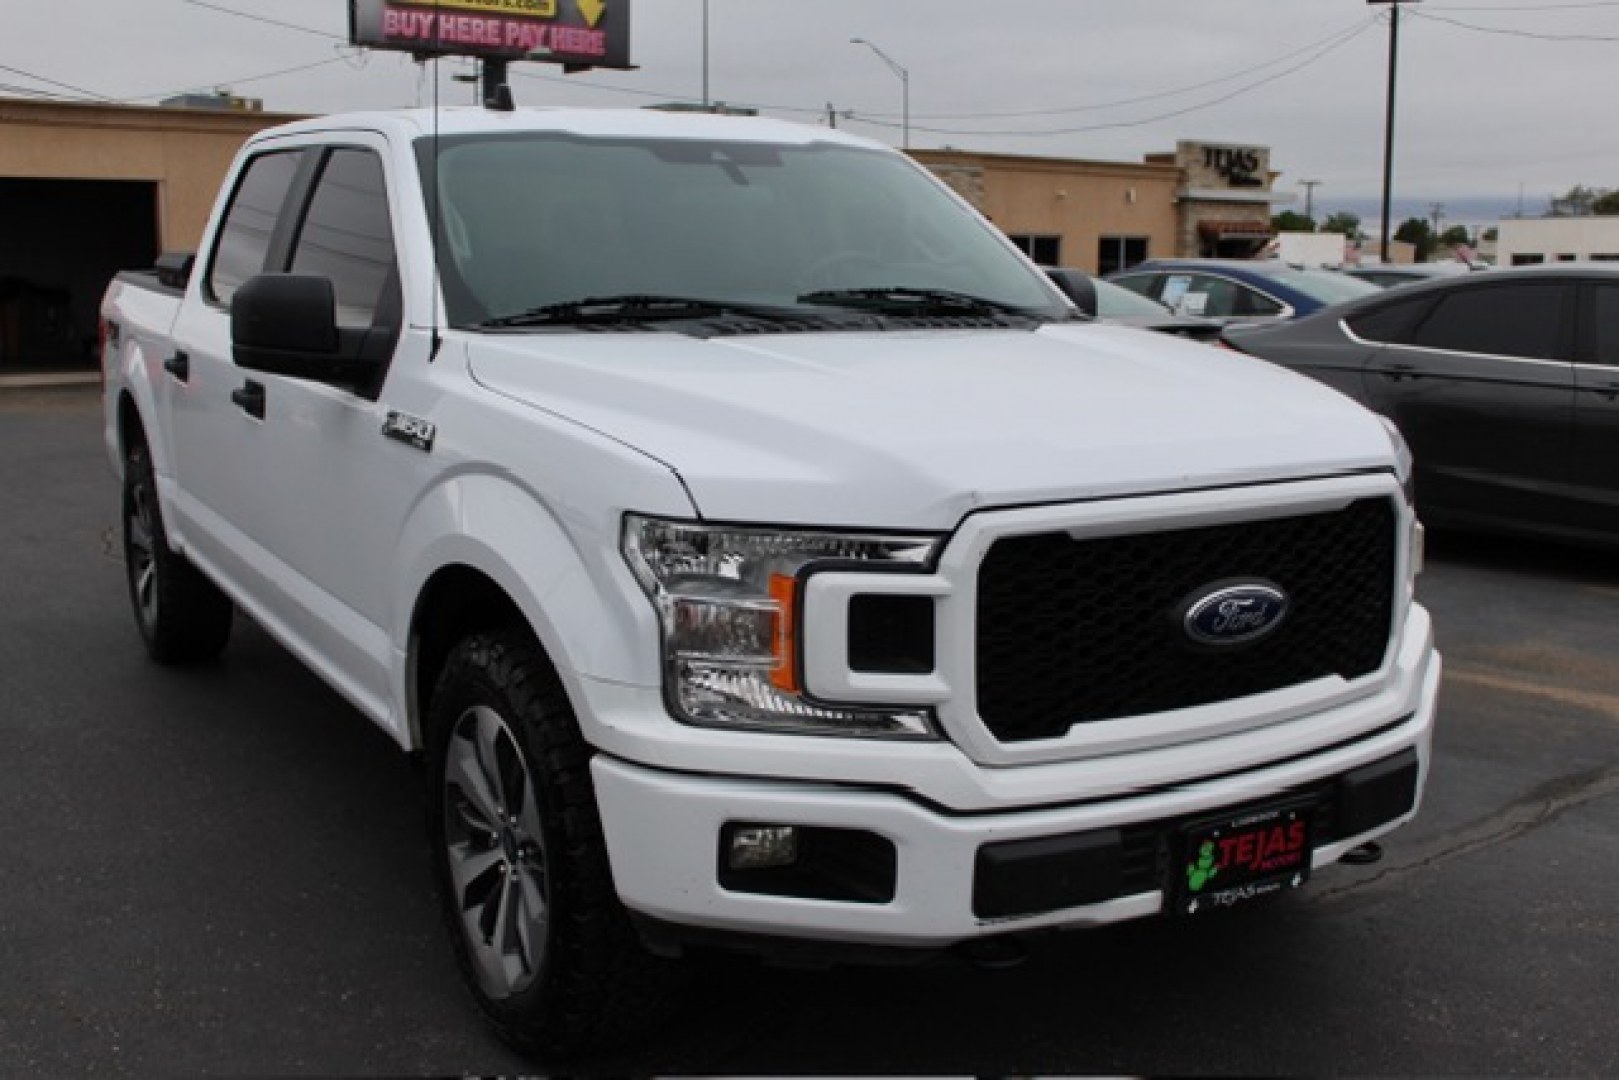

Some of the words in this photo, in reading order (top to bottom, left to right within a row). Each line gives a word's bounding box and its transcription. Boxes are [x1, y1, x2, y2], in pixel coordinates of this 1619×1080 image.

[385, 10, 434, 38] BUY
[440, 15, 501, 42] HERE
[506, 23, 548, 47] PAY
[552, 27, 605, 55] HERE
[1213, 599, 1268, 633] Ford
[1215, 821, 1306, 870] TEJAS
